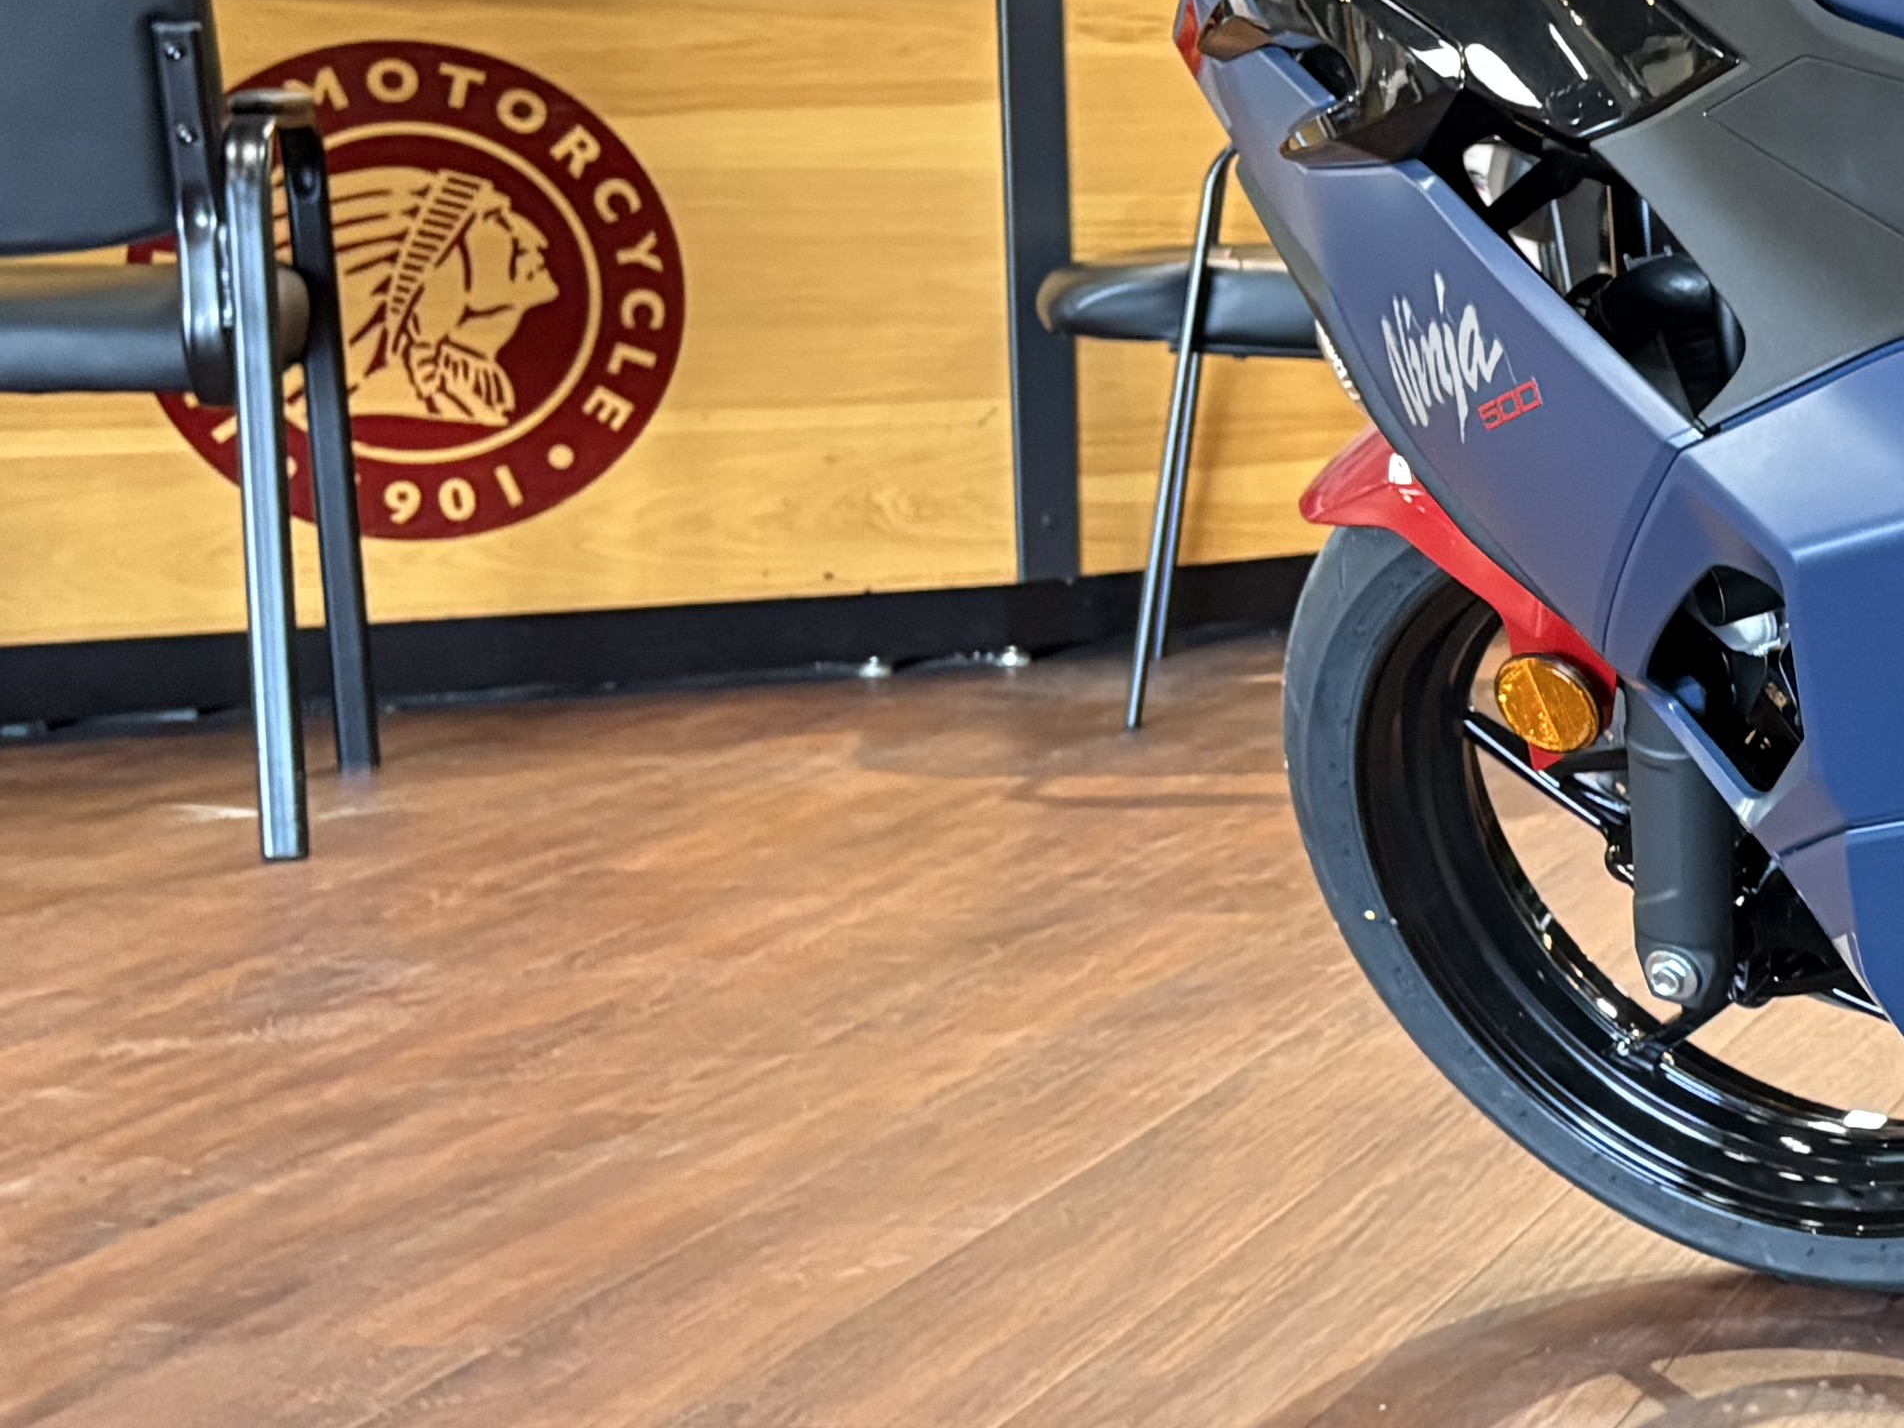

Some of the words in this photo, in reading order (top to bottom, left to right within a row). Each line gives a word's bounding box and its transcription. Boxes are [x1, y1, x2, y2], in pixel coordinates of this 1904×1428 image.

[283, 59, 666, 432] MOTORCYCLE
[1381, 269, 1504, 445] Ninja
[1477, 377, 1543, 431] 500
